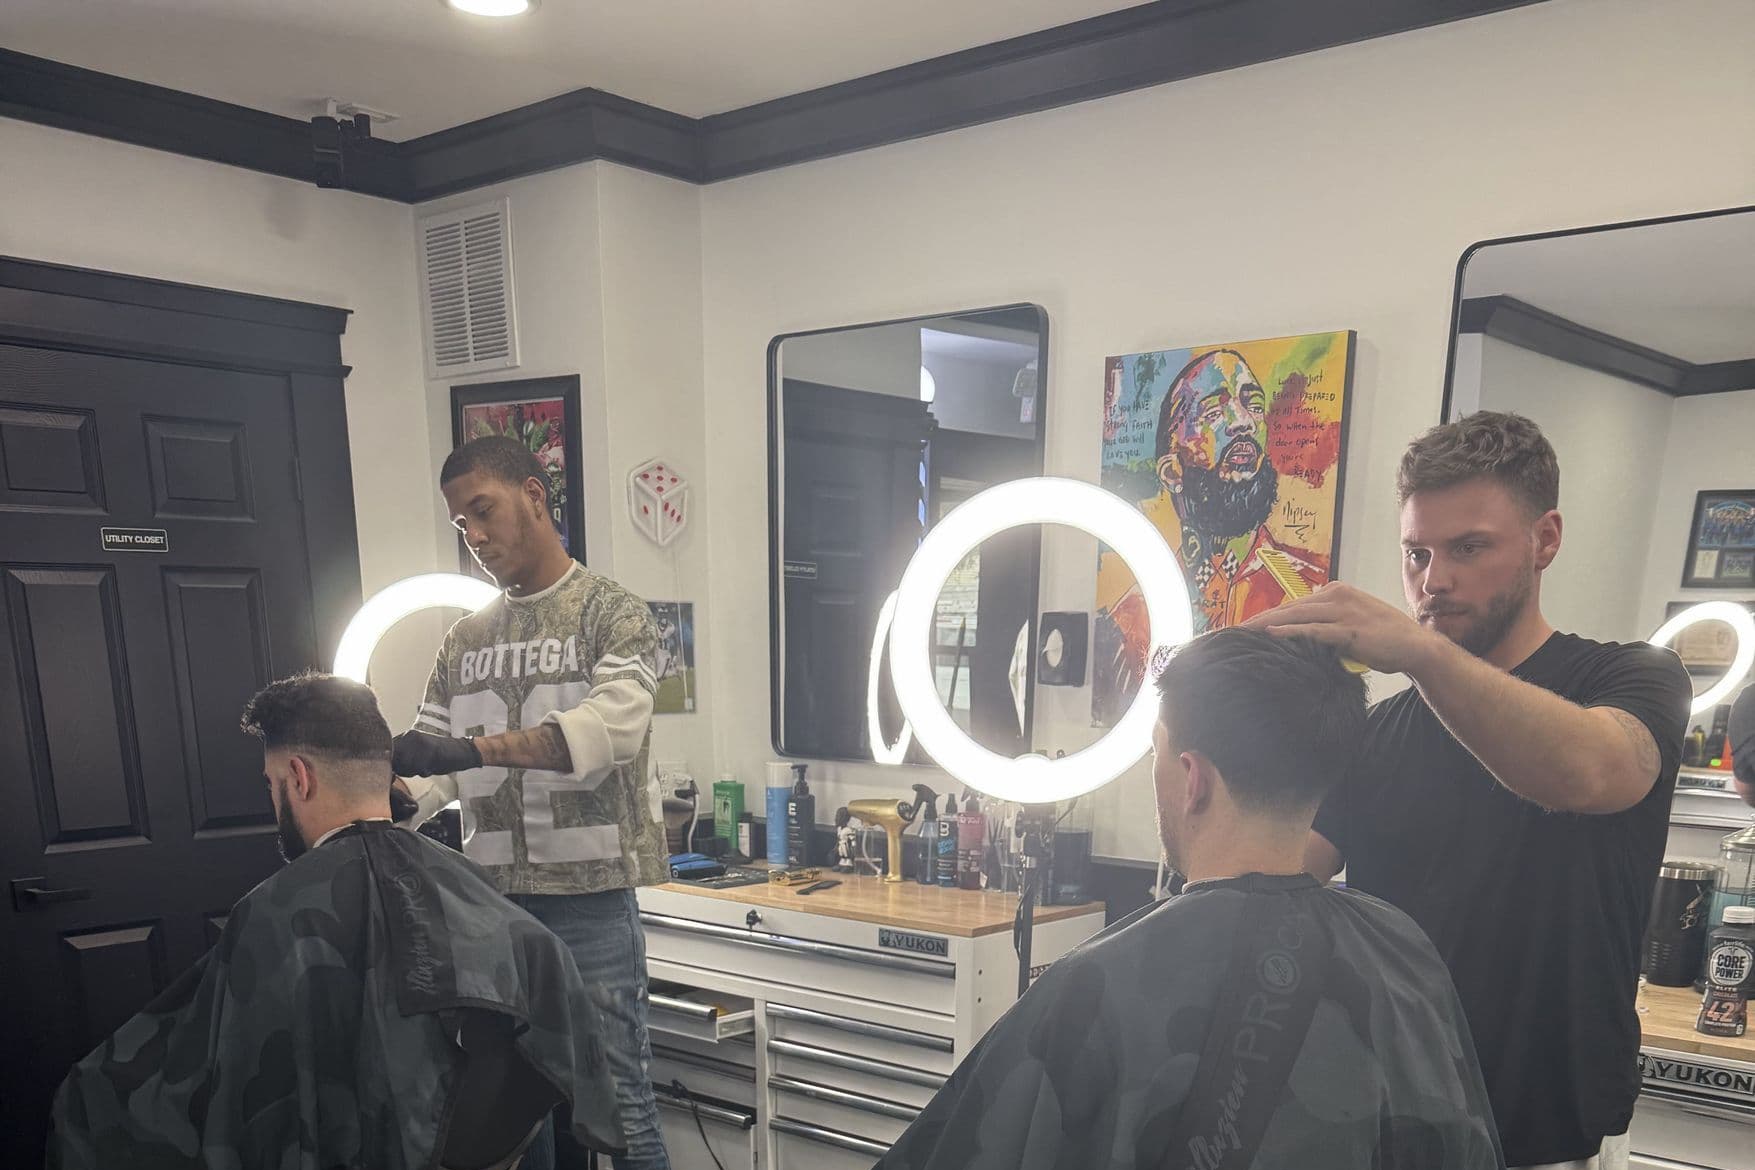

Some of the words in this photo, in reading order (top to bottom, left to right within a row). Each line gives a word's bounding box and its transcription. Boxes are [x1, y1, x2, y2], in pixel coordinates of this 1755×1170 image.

[104, 534, 134, 544] UTILITY
[134, 535, 165, 545] CLOSET
[459, 634, 580, 686] BOTTEGA
[894, 933, 946, 954] YUKON
[1716, 953, 1748, 969] CORE
[1714, 966, 1745, 979] POWER
[1655, 1060, 1753, 1092] YUKON
